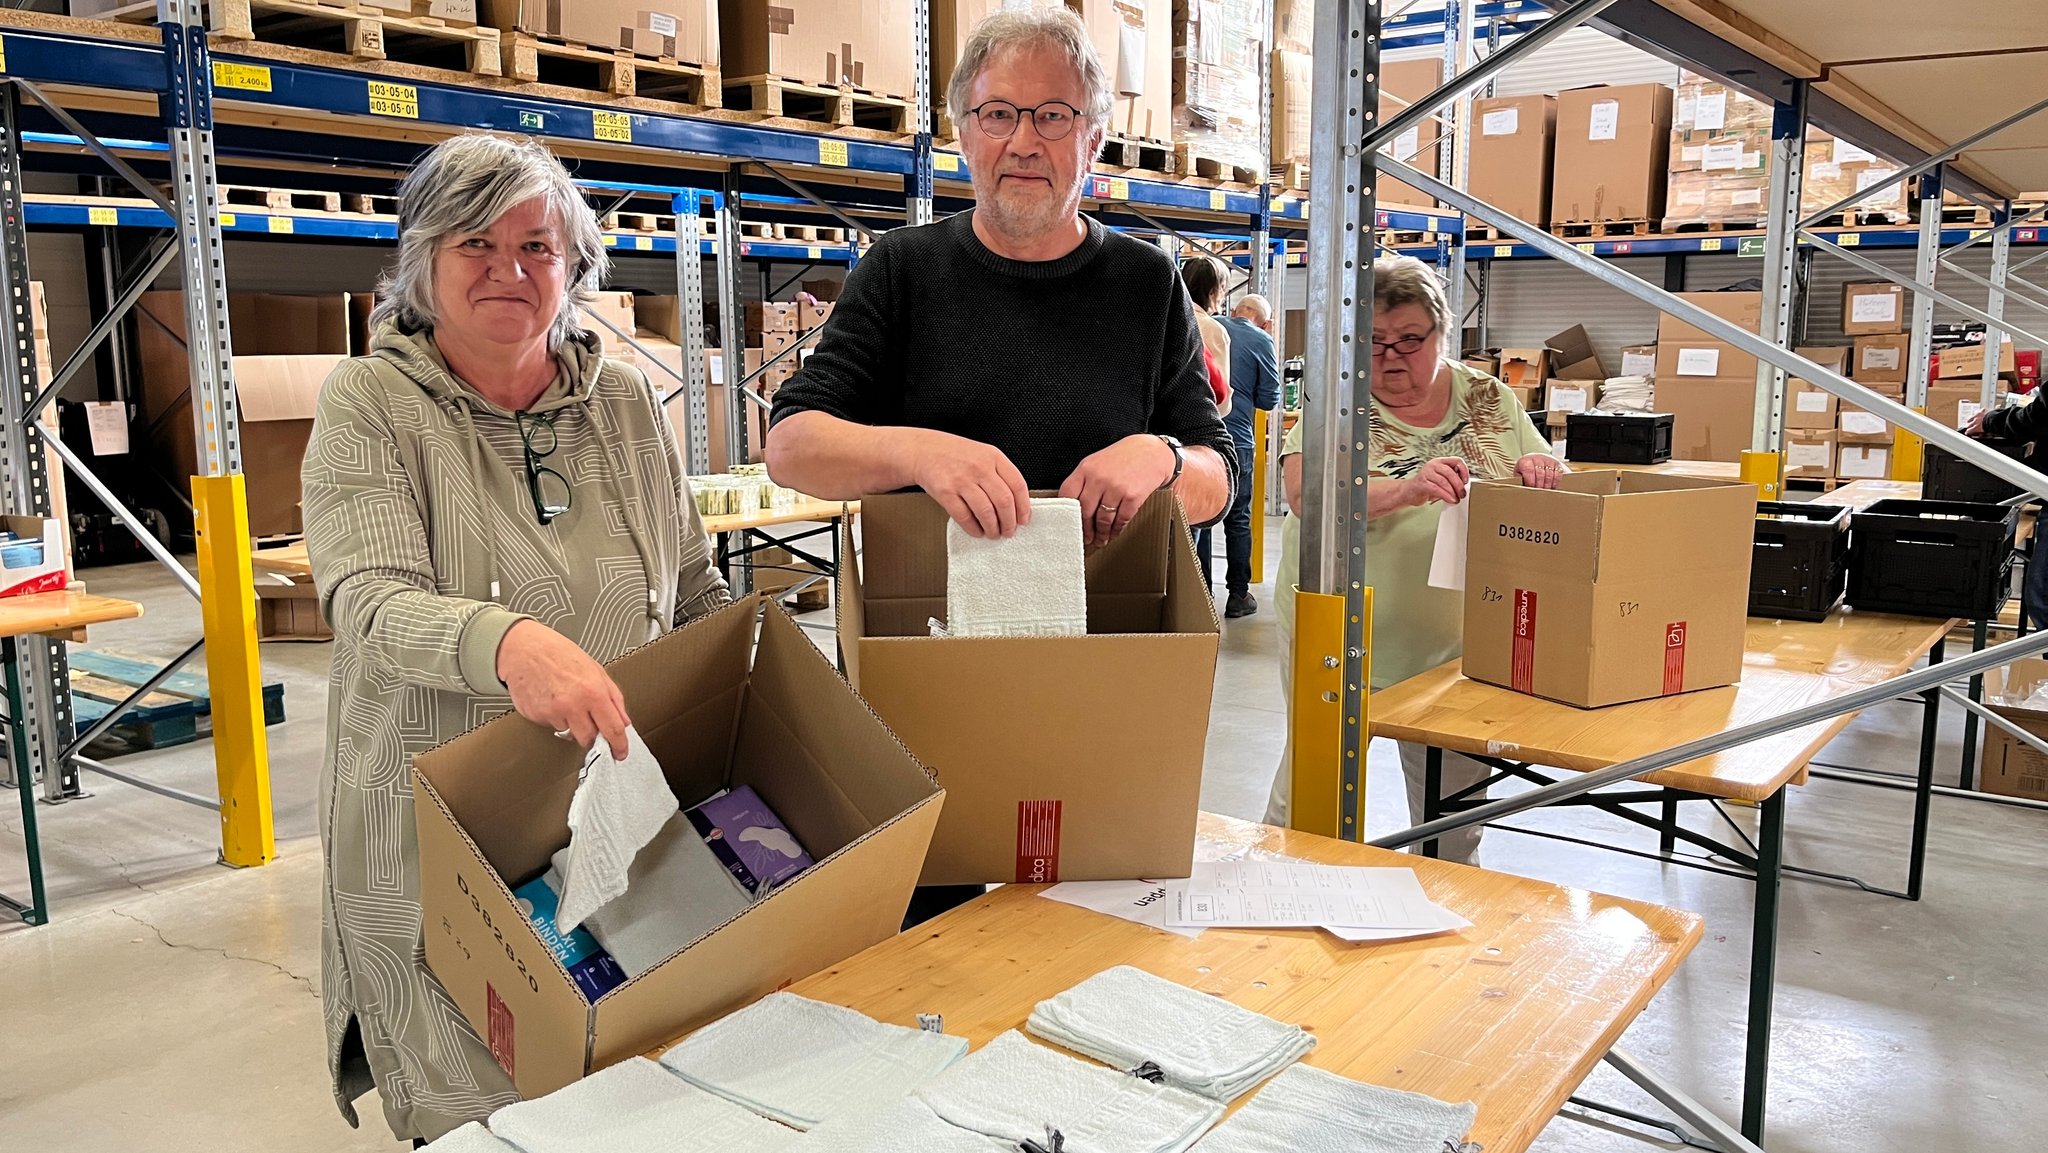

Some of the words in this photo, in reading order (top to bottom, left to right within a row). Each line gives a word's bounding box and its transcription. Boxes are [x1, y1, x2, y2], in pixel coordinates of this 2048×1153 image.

[374, 84, 415, 99] 03-05-04
[376, 101, 415, 116] 03-05-01
[597, 113, 629, 126] 03-05-05
[599, 127, 630, 140] 03-05-02
[1499, 523, 1560, 545] D382820
[457, 873, 538, 993] D382820
[533, 916, 570, 961] BINDEN
[549, 917, 576, 953] XI-
